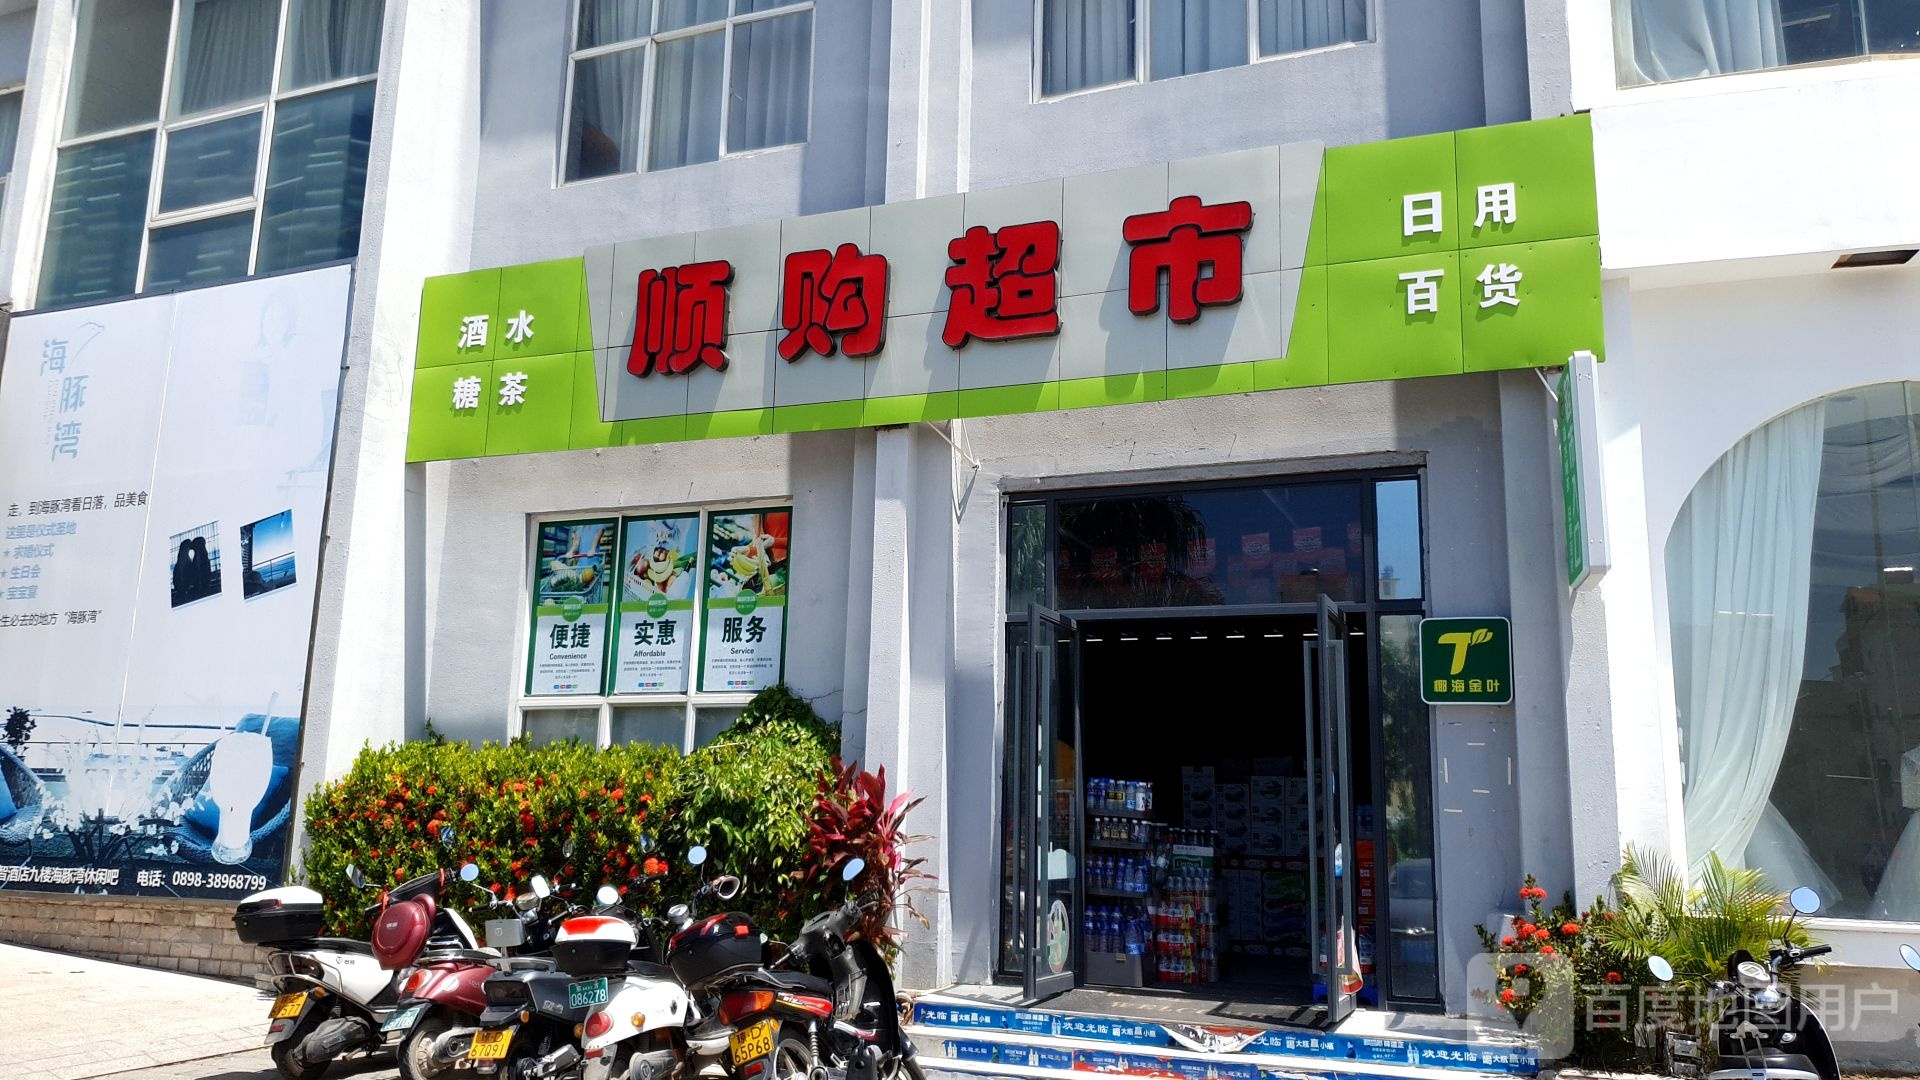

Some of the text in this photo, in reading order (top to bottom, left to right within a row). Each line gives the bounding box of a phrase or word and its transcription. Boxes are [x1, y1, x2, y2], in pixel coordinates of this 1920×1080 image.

[1403, 181, 1517, 237] 日用
[626, 194, 1255, 378] 顺购超市
[1398, 262, 1523, 314] 百货
[457, 309, 536, 350] 酒水
[40, 338, 89, 462] 海豚湾
[452, 371, 529, 410] 糖茶
[10, 564, 41, 579] 生日会
[549, 622, 591, 649] 便捷
[633, 618, 677, 646] 实惠
[721, 615, 767, 643] 服务
[549, 652, 587, 660] Convenience
[633, 649, 666, 657] Affordable
[730, 647, 755, 655] Service
[1433, 679, 1500, 693] 椰海金叶
[172, 871, 267, 890] 0898-38968799
[571, 988, 607, 1007] 086278
[1062, 1022, 1109, 1034] 欢迎光临
[734, 1036, 771, 1063] 65P68
[1421, 1049, 1478, 1062] 欢迎光临
